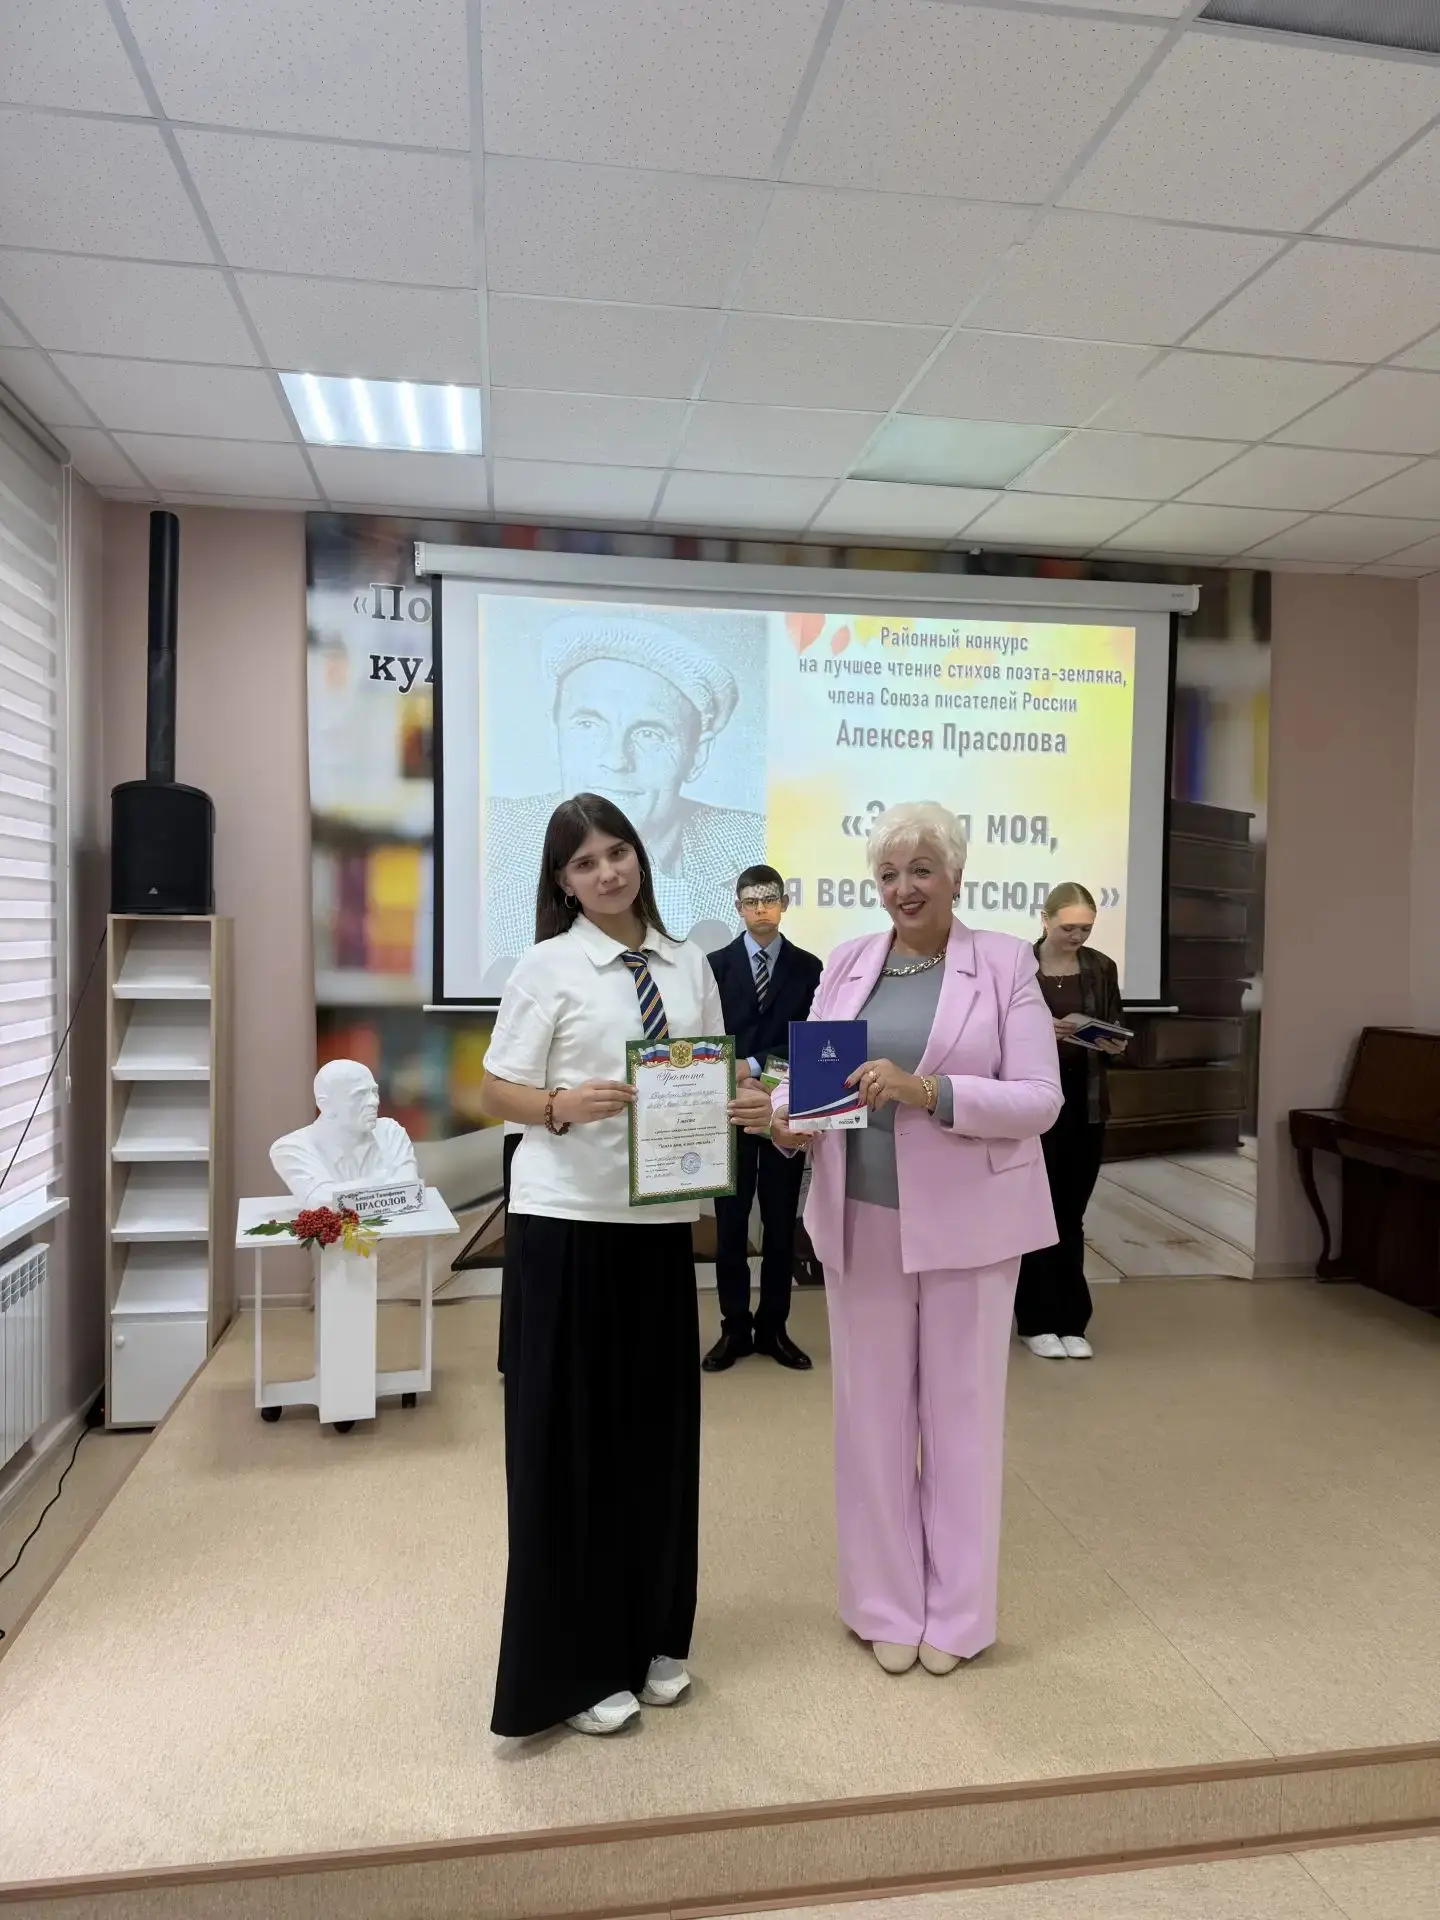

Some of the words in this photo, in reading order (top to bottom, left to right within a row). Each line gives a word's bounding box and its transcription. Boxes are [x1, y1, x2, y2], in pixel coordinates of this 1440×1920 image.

[881, 626, 960, 648] Районный
[966, 634, 1029, 656] конкурс
[799, 657, 818, 673] на
[824, 658, 882, 678] лучшее
[888, 661, 942, 678] чтение
[948, 663, 1000, 680] стихов
[1006, 666, 1126, 688] поэта-земляка,
[828, 688, 875, 705] члена
[881, 687, 929, 708] Союза
[935, 690, 1017, 711] писателей
[1023, 692, 1077, 713] России
[836, 718, 933, 750] Алексея
[942, 722, 1067, 757] Прасолова
[987, 814, 1059, 854] моя,
[817, 877, 884, 908] вес
[657, 1068, 705, 1086] Грамота
[355, 1196, 407, 1212] ПРАСОЛОВ
